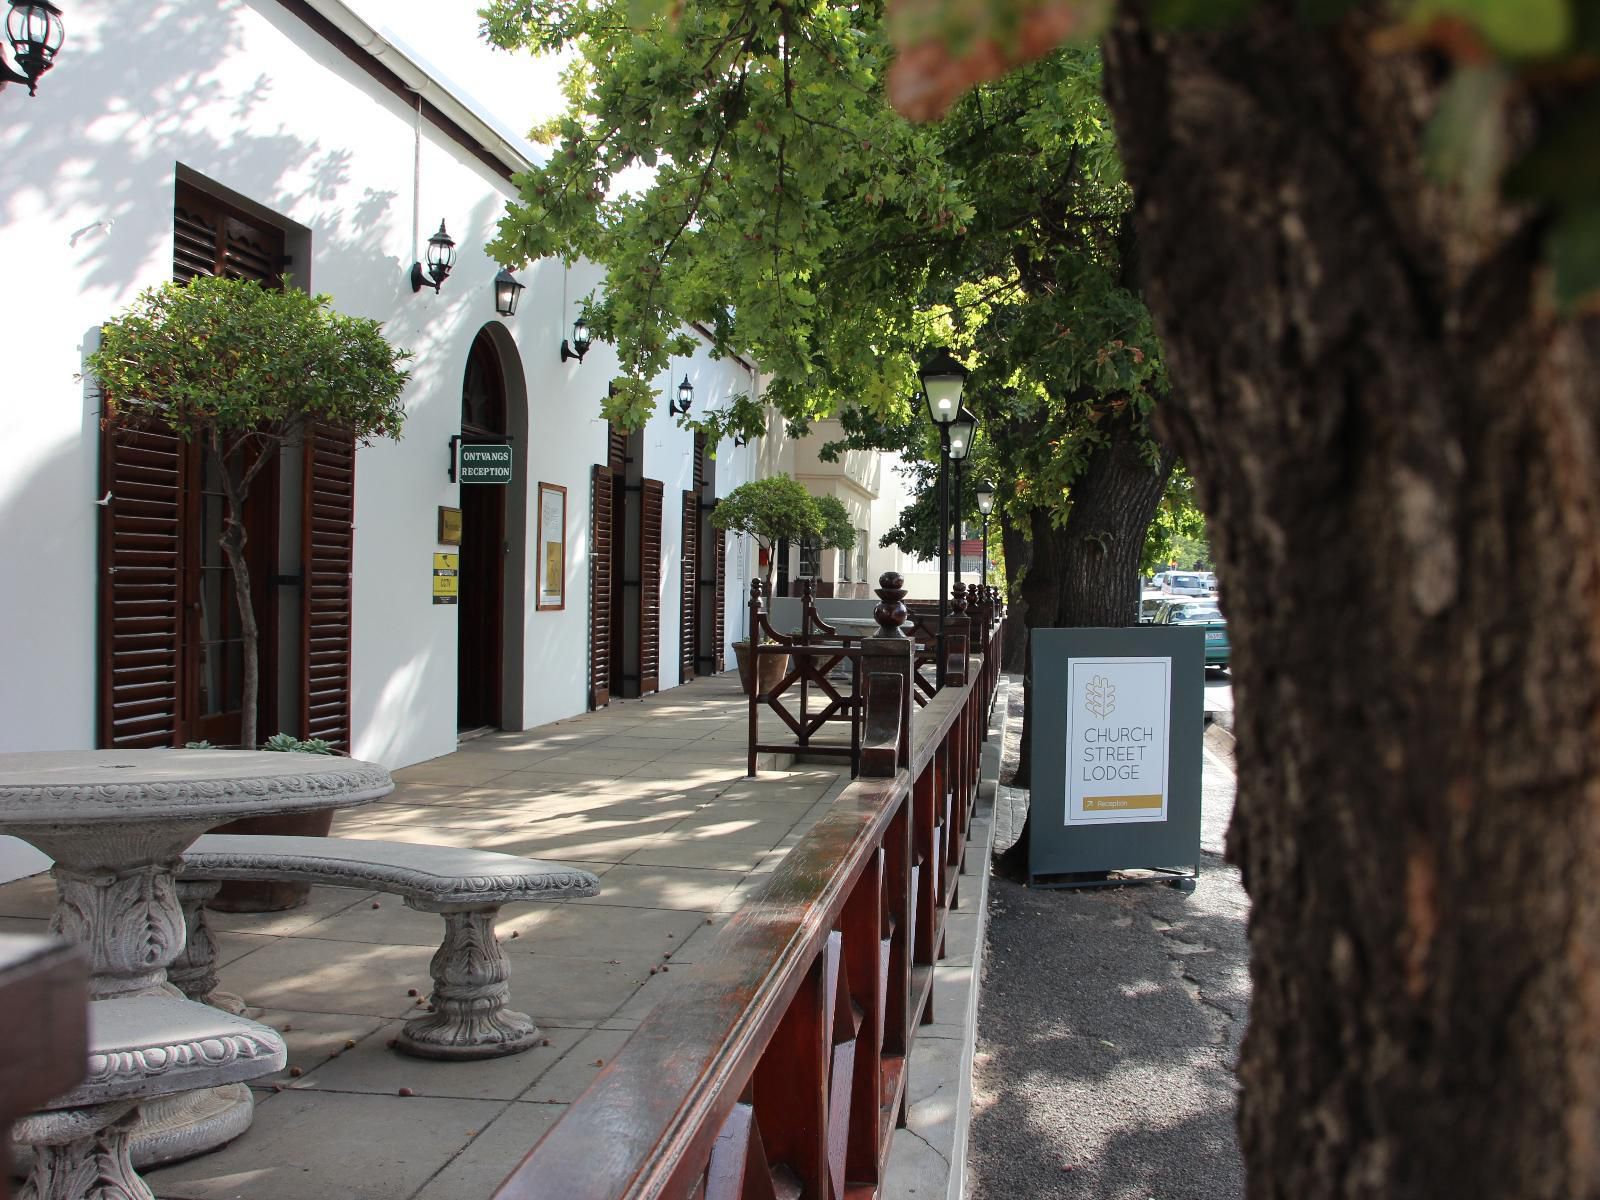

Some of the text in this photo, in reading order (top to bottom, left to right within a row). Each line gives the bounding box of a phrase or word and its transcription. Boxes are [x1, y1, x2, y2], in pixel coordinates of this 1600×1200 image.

[463, 452, 509, 461] ONTVANGS
[461, 467, 510, 476] RECEPTION
[1084, 727, 1153, 743] CHURCH
[1083, 746, 1147, 762] STREET
[1083, 765, 1140, 782] LODGE
[1097, 799, 1128, 808] Reception
